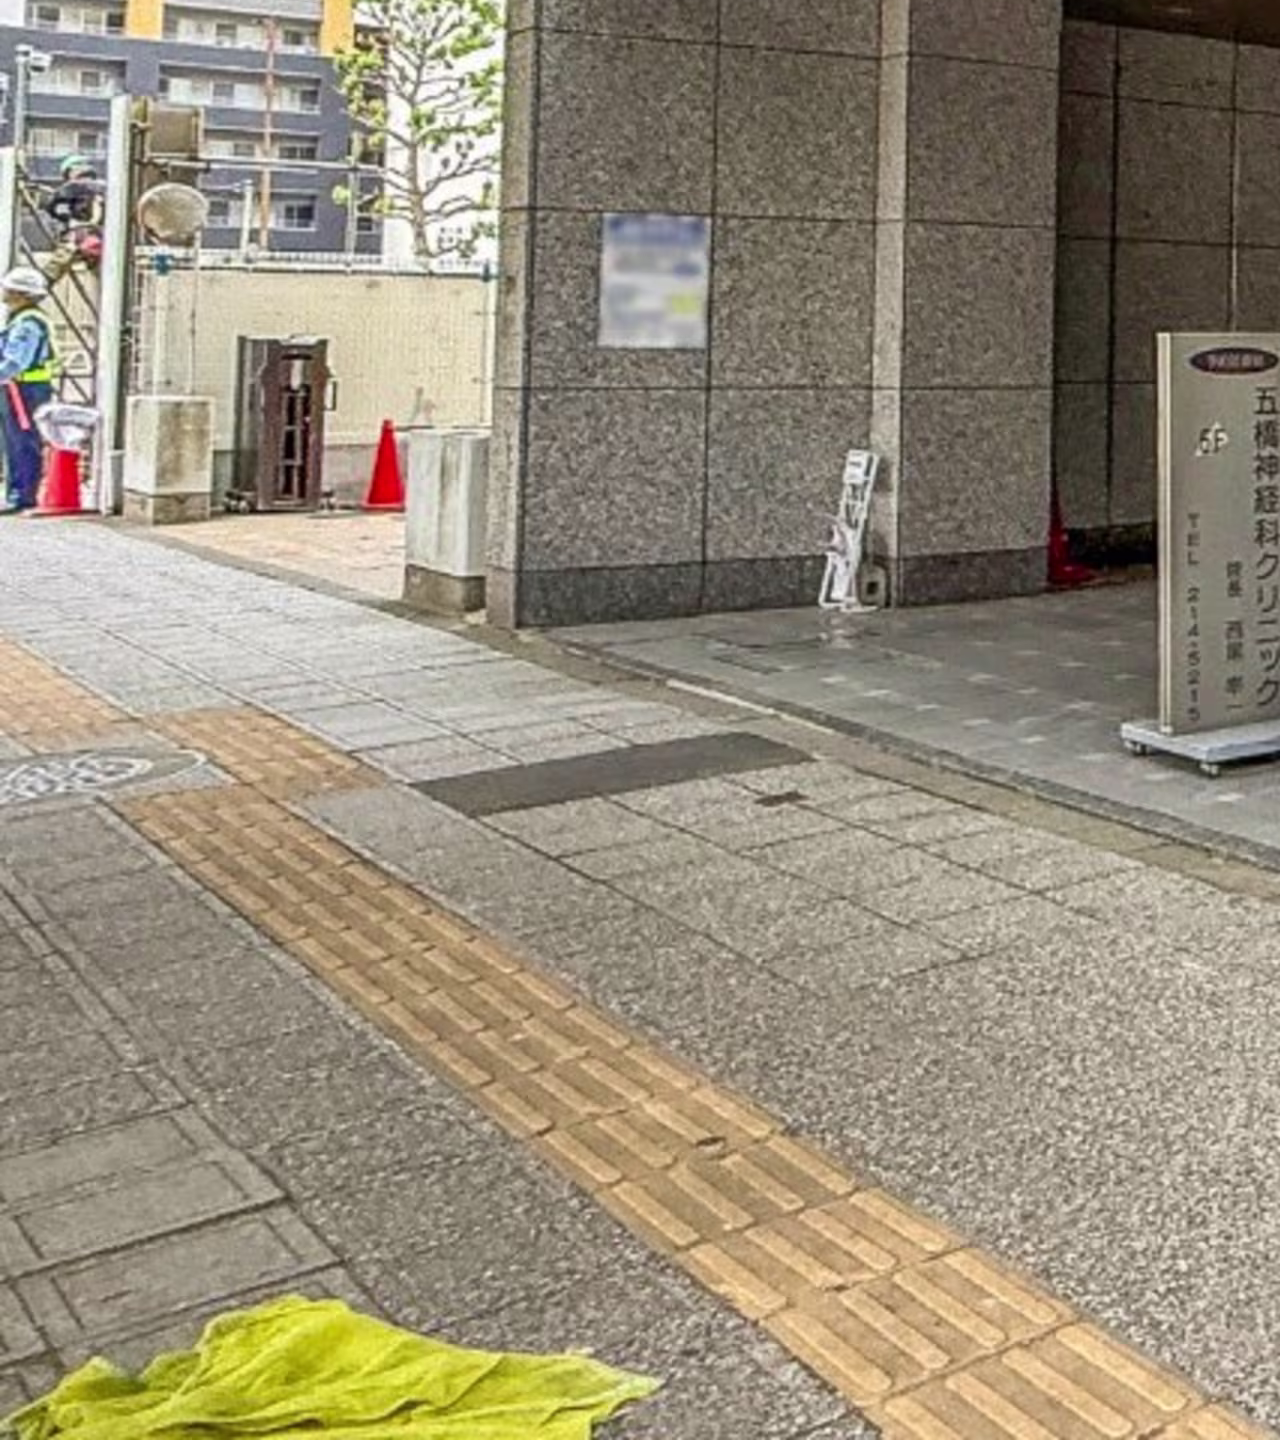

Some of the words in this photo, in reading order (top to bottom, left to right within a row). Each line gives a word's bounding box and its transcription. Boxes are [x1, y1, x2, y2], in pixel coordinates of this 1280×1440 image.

[1253, 385, 1280, 707] 五橋神経科クリニック
